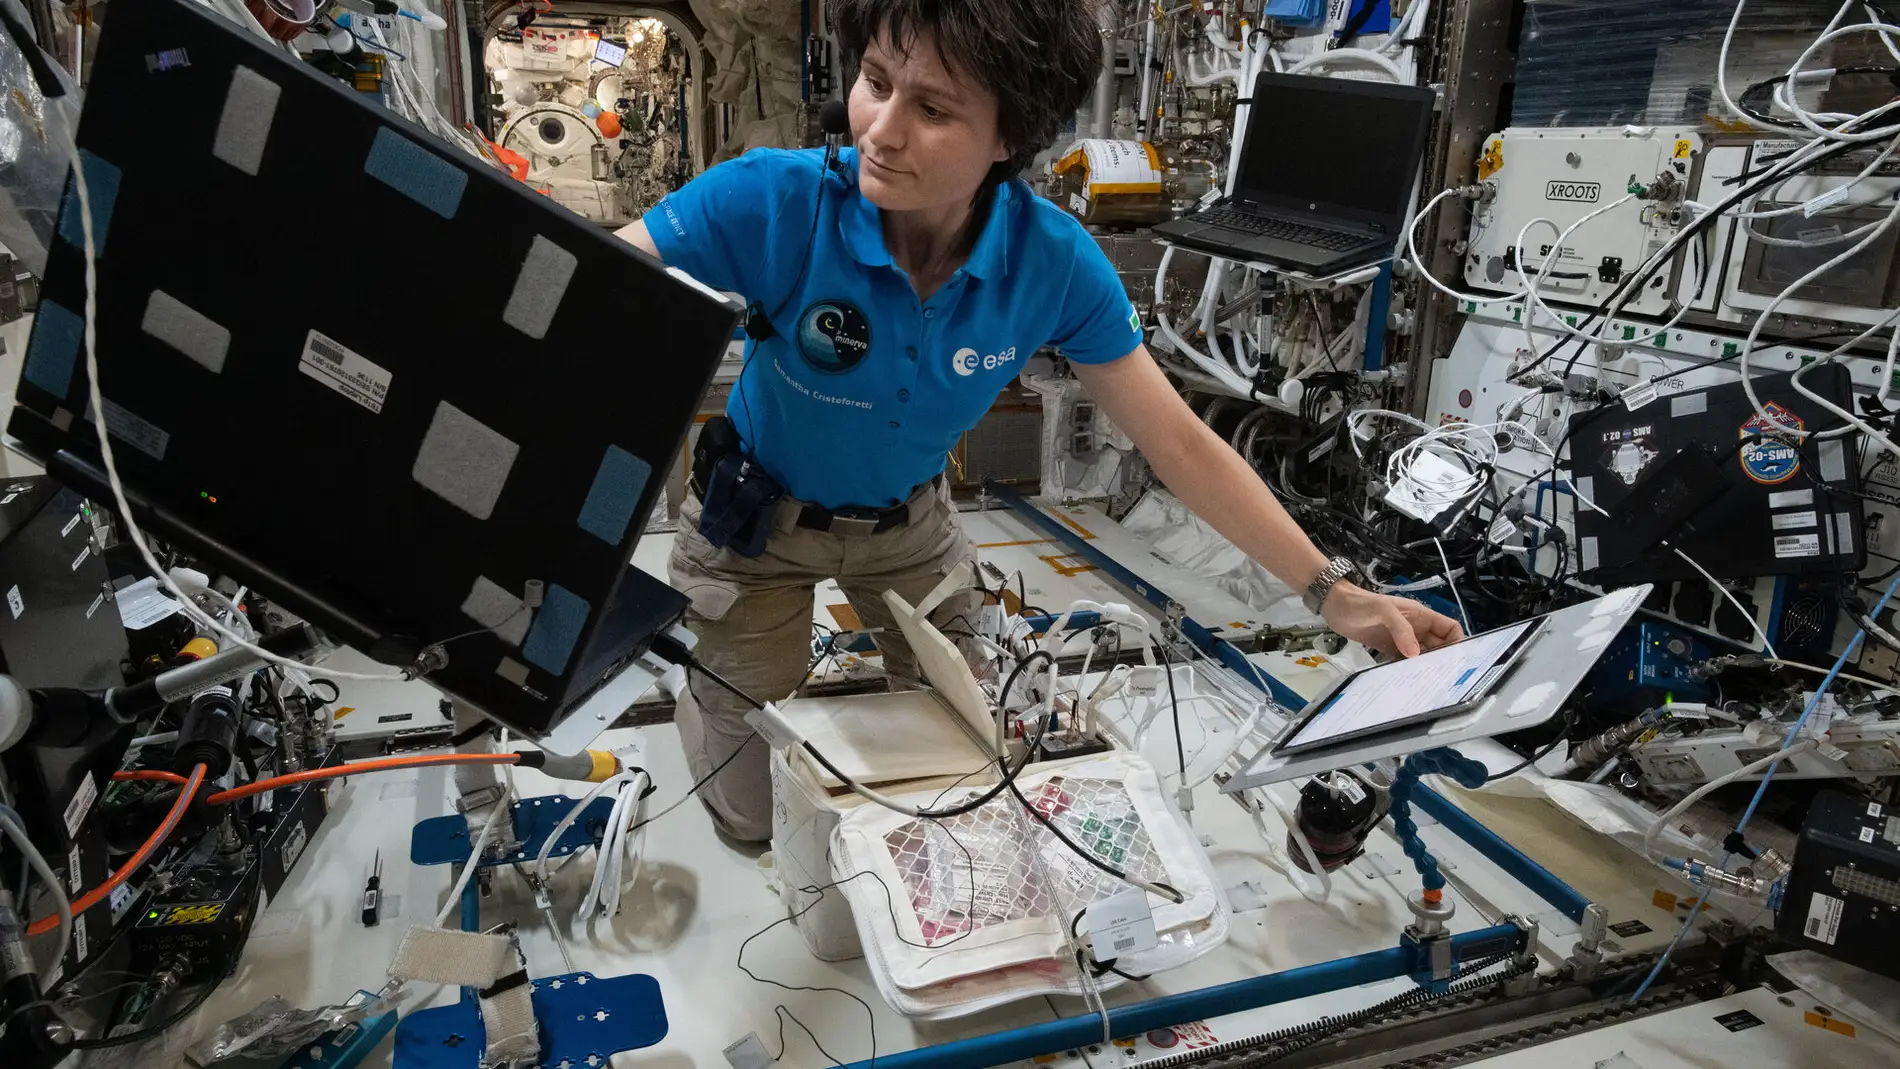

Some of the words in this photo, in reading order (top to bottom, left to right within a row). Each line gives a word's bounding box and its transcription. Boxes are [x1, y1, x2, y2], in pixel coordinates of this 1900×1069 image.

[362, 17, 391, 29] aha
[1548, 184, 1597, 199] XROOTS
[834, 334, 867, 350] minerva
[983, 346, 1016, 370] esa
[773, 358, 809, 396] Samantha
[812, 390, 873, 410] Cristoforetti
[1505, 424, 1526, 436] SMOKE
[1603, 431, 1620, 442] 02.1
[1632, 425, 1651, 437] AMS
[1748, 448, 1795, 462] AMS-02
